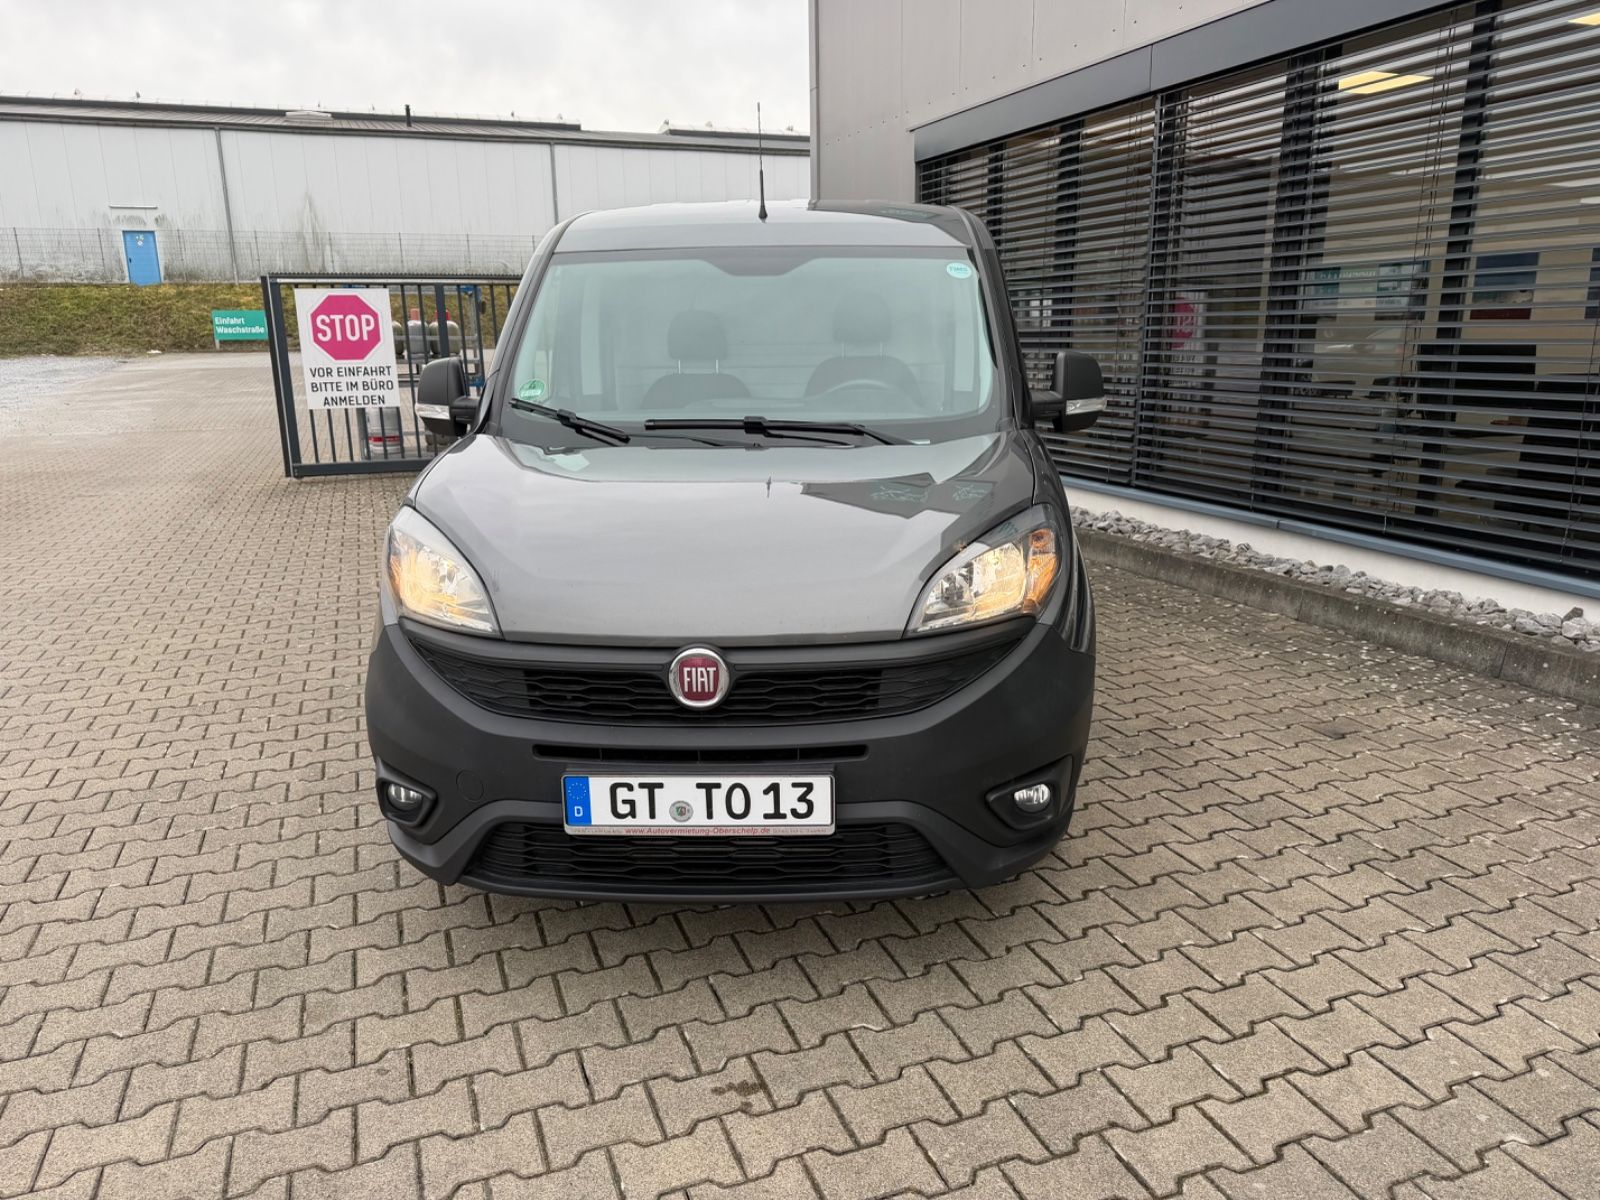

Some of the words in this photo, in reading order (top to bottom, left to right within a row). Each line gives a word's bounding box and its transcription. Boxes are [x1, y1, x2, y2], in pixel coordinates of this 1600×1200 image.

[215, 316, 245, 325] Einfahrt
[216, 325, 265, 334] Waschstraße
[316, 314, 375, 342] STOP
[309, 367, 334, 378] VOR
[337, 366, 392, 377] EINFAHRT
[311, 381, 343, 392] BITTE
[346, 381, 359, 391] IM
[362, 378, 394, 391] BÜRO
[323, 395, 386, 407] ANMELDEN
[683, 667, 717, 692] FIAT
[609, 782, 665, 820] GT
[696, 782, 752, 820] TO
[762, 782, 815, 820] 13
[574, 806, 584, 817] D
